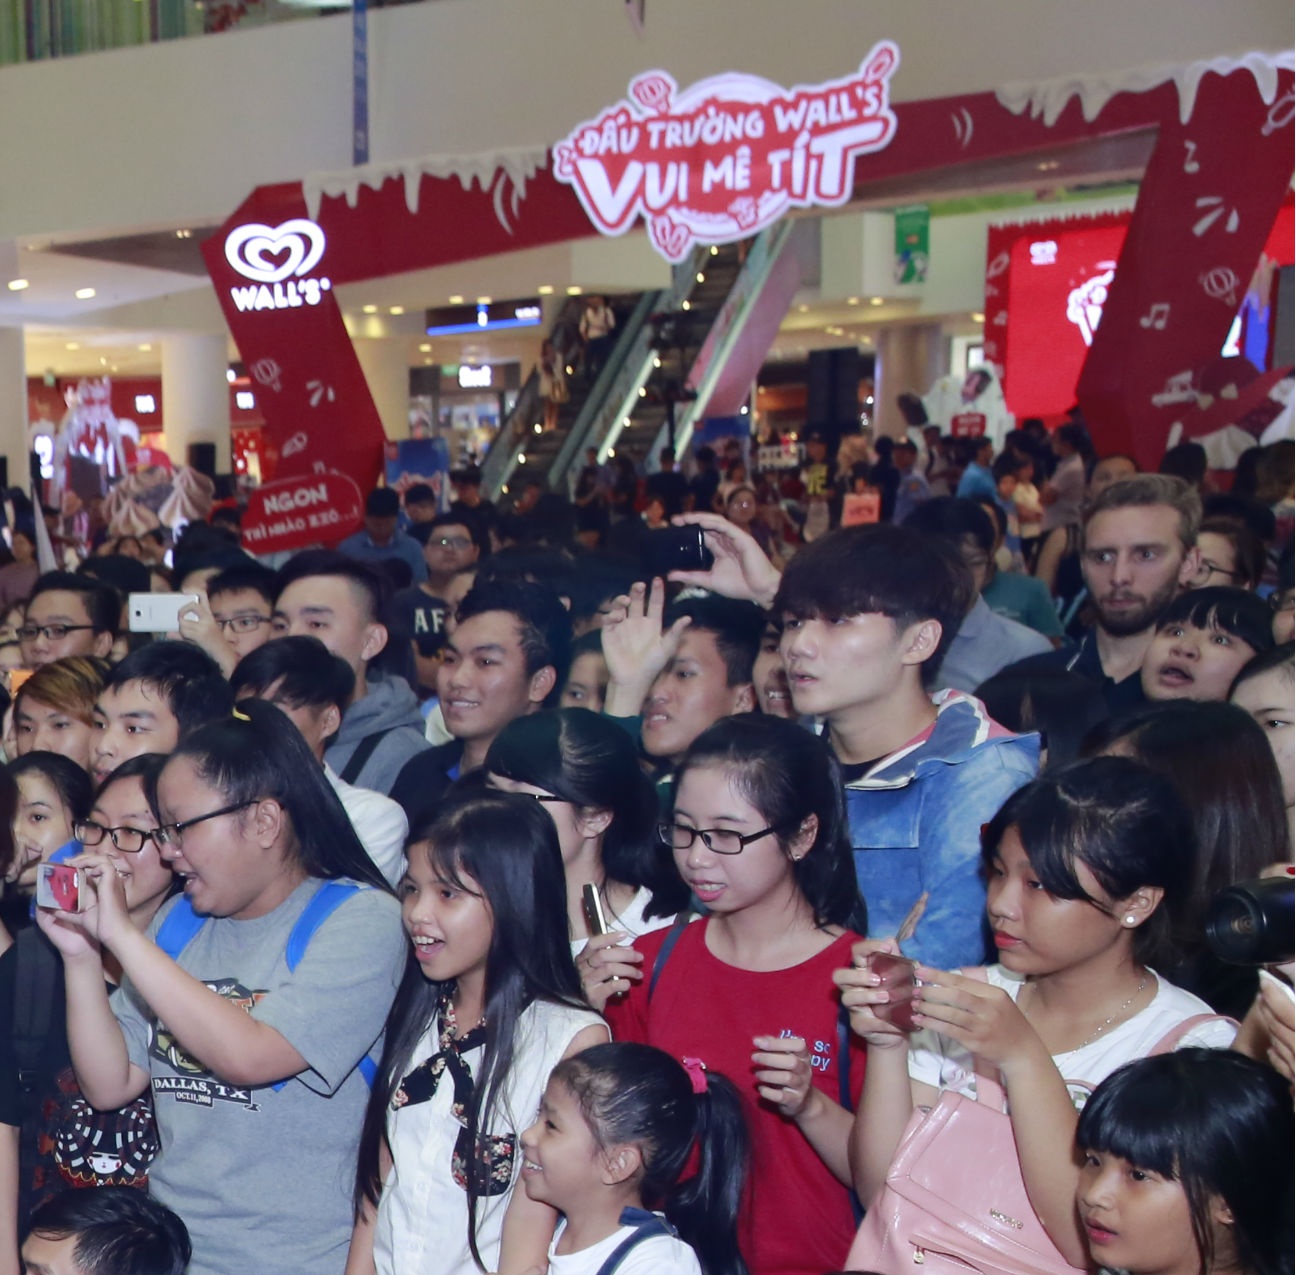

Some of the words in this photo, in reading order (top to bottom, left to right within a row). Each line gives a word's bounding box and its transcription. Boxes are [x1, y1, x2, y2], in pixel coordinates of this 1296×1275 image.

[578, 109, 640, 156] ĐẤU
[646, 103, 765, 151] TRƯỜNG
[772, 84, 882, 133] WALL'S
[574, 156, 689, 226] VUI
[701, 145, 752, 194] MÊ
[767, 119, 884, 197] TÍT
[230, 281, 322, 312] WALL'S
[263, 483, 328, 515] NGON
[154, 1078, 211, 1095] DALLAS,
[215, 1084, 249, 1100] TX
